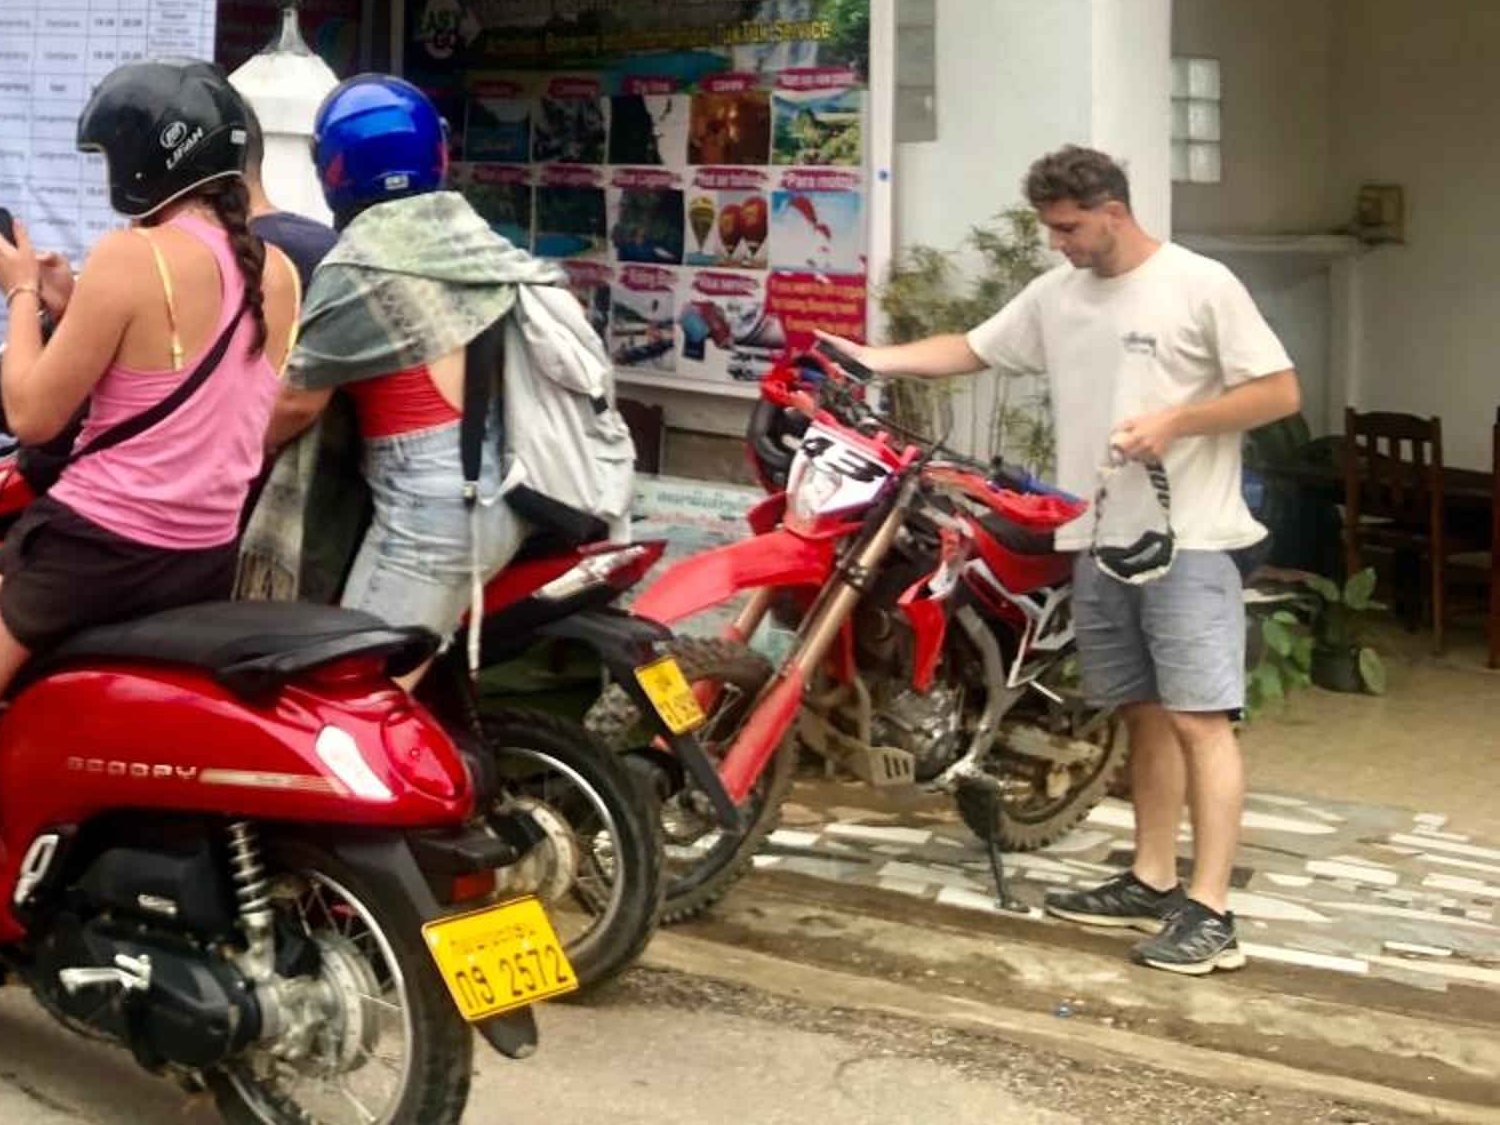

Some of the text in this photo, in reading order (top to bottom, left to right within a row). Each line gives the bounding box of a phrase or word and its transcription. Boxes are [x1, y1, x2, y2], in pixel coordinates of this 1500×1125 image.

[166, 126, 203, 170] LIFAN
[67, 756, 197, 780] SCOOPY
[499, 944, 568, 997] 2572
